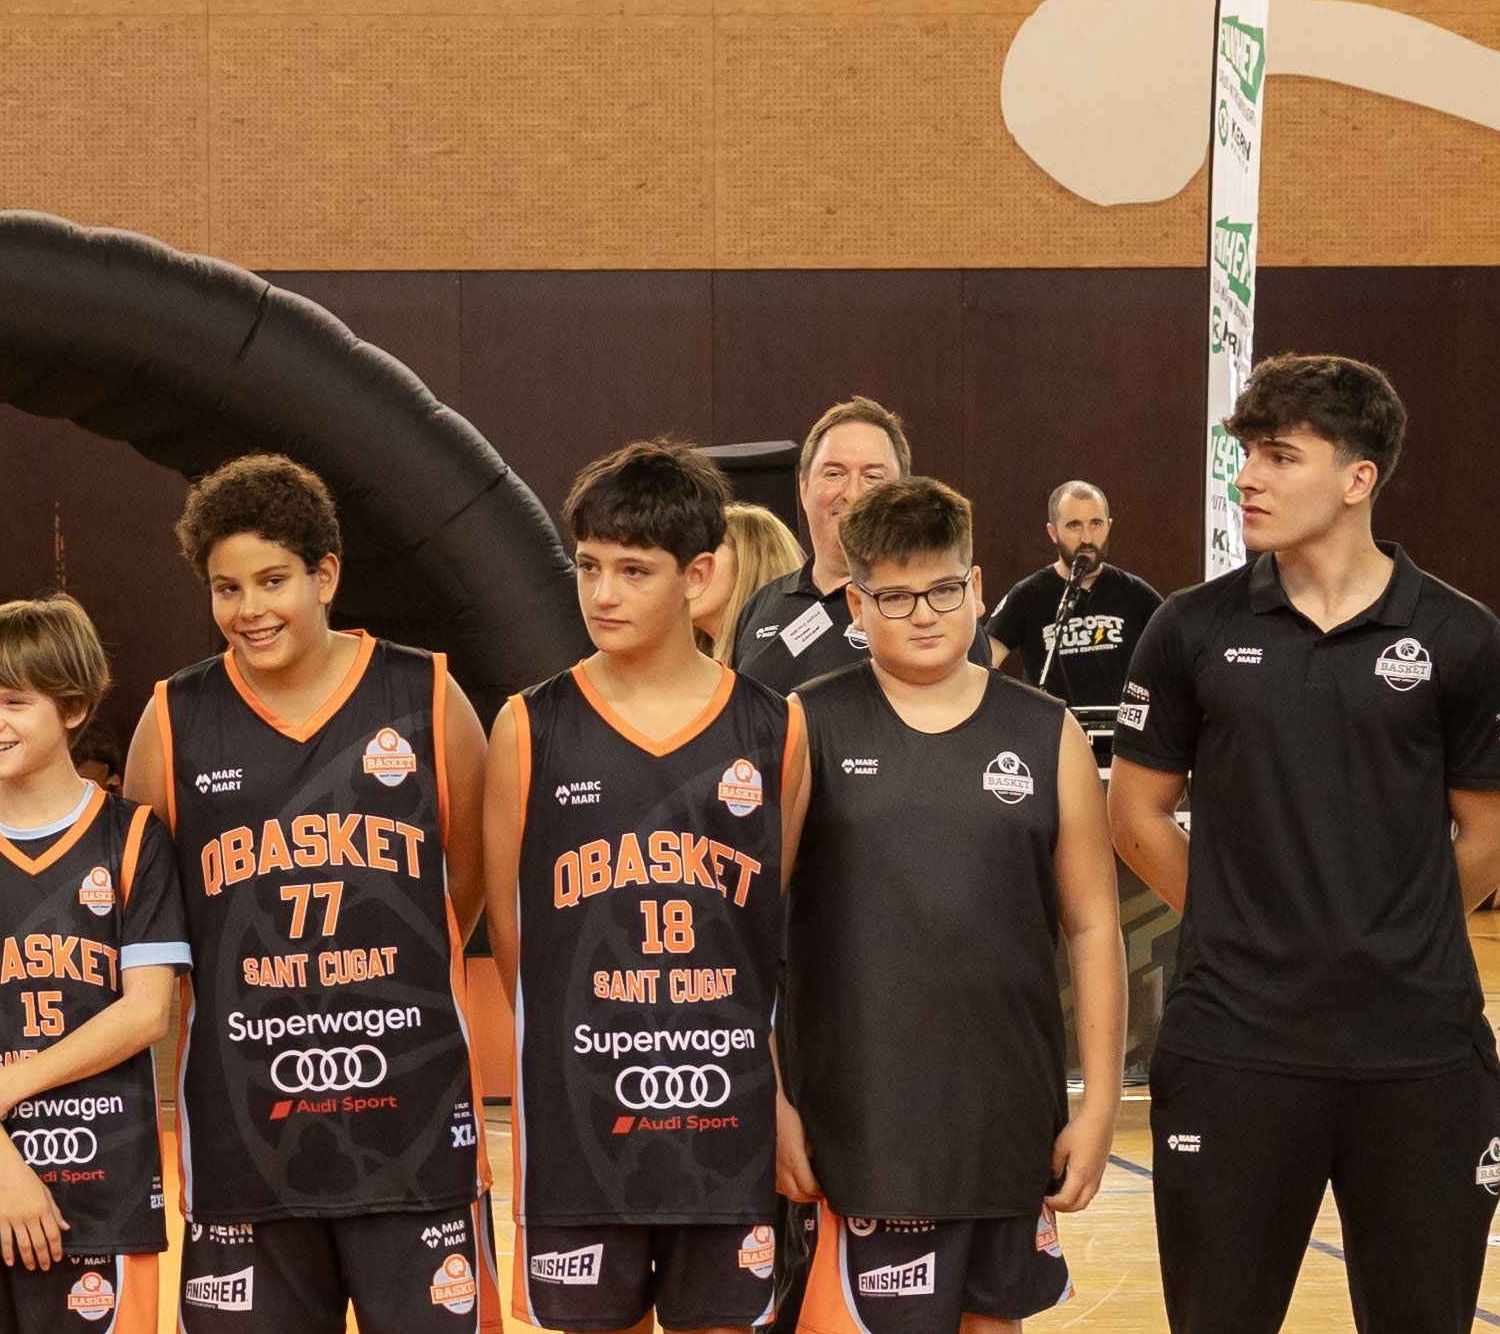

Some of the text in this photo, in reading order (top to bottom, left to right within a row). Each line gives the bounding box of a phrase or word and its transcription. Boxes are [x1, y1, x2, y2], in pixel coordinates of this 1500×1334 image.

[1237, 647, 1263, 656] MARC
[1237, 656, 1263, 665] MART
[1380, 661, 1427, 676] BASKET
[367, 757, 414, 769] BASKET
[854, 758, 879, 767] MARC
[212, 768, 243, 780] MARC
[854, 767, 879, 775] MART
[212, 780, 242, 792] MART
[570, 780, 602, 792] MARC
[987, 776, 1031, 790] BASKET
[571, 793, 601, 805] MART
[721, 785, 762, 801] BASKET
[201, 813, 425, 897] QBASKET
[554, 831, 762, 909] QBASKET
[82, 890, 114, 902] BASKE
[279, 881, 344, 939] 77
[640, 900, 695, 954] 18
[243, 947, 397, 987] SANT CUGAT
[593, 969, 736, 1004] SANT CUGAT
[21, 990, 65, 1037] 15
[227, 1006, 421, 1045] Superwagen
[573, 1024, 755, 1059] Superwagen
[295, 1096, 397, 1113] Audi Sport
[638, 1115, 739, 1132] Audi Sport
[450, 1124, 476, 1148] XL
[1178, 1135, 1201, 1144] MARC
[1178, 1144, 1200, 1152] MART
[61, 1169, 105, 1183] Sport
[442, 1220, 466, 1233] MAR
[860, 1262, 928, 1291] FINISHER
[72, 1296, 114, 1307] BASKET
